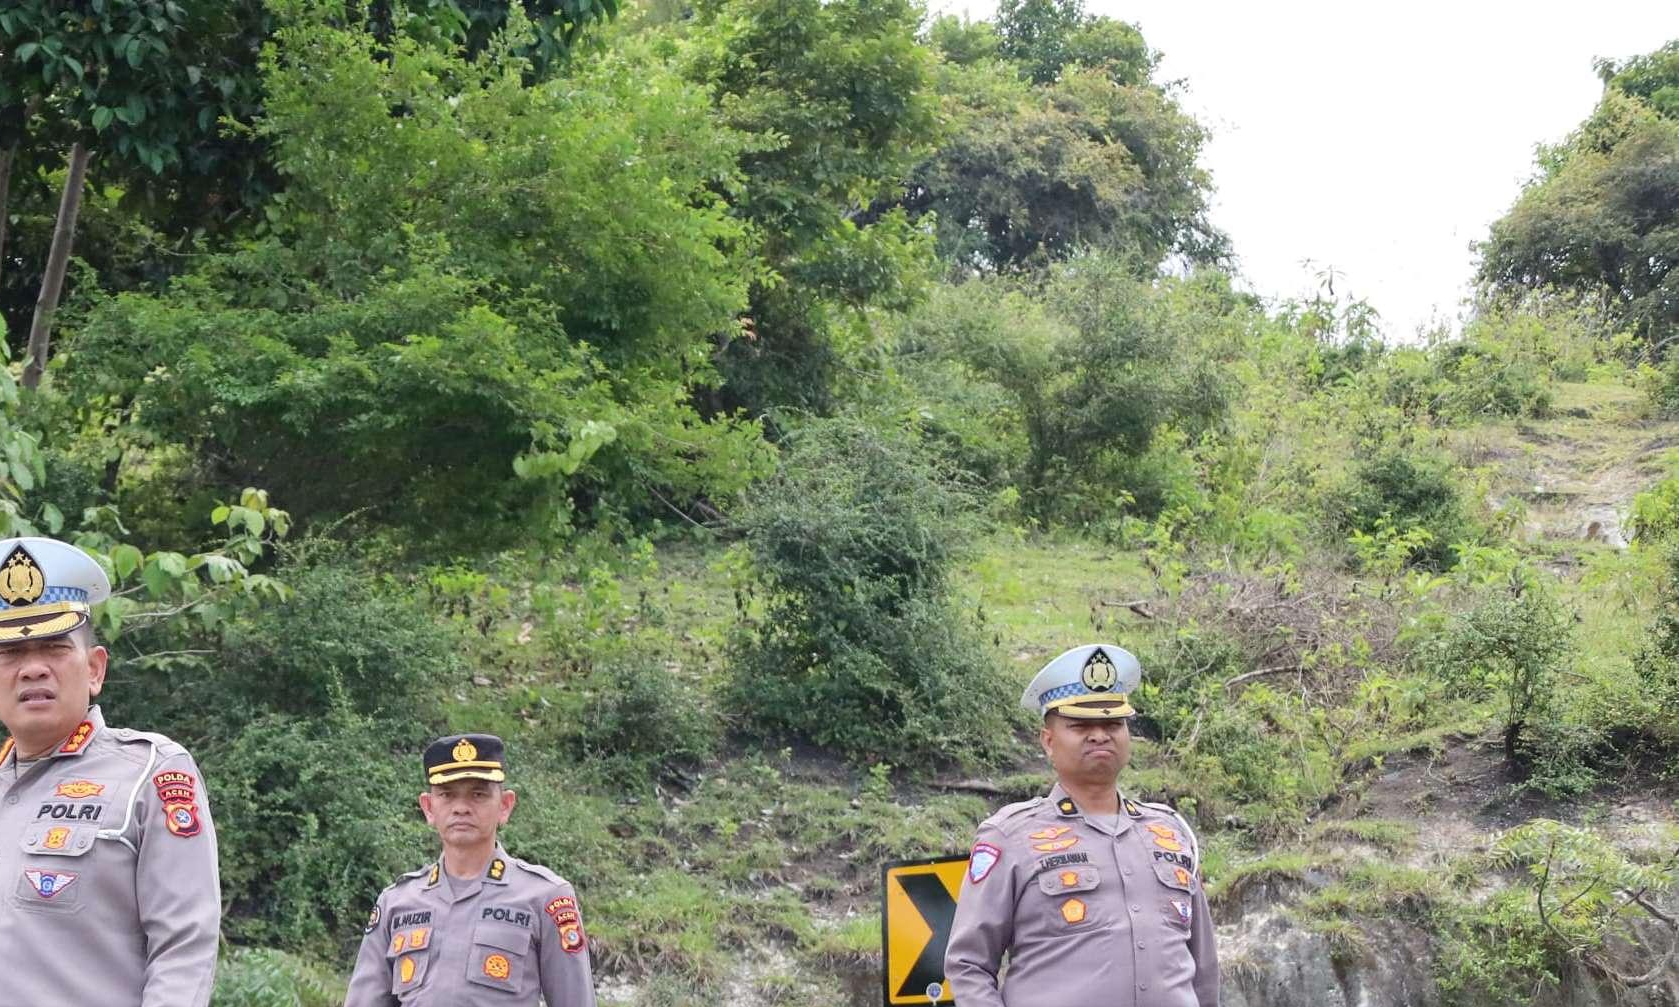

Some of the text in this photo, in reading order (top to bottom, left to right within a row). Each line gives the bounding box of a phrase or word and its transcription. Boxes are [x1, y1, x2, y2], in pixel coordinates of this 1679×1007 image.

[158, 773, 191, 785] POLDA
[165, 789, 191, 798] ACEH
[36, 803, 102, 821] POLRI
[1153, 851, 1192, 869] POLRI
[549, 898, 574, 911] POLDA
[482, 907, 531, 927] POLRI
